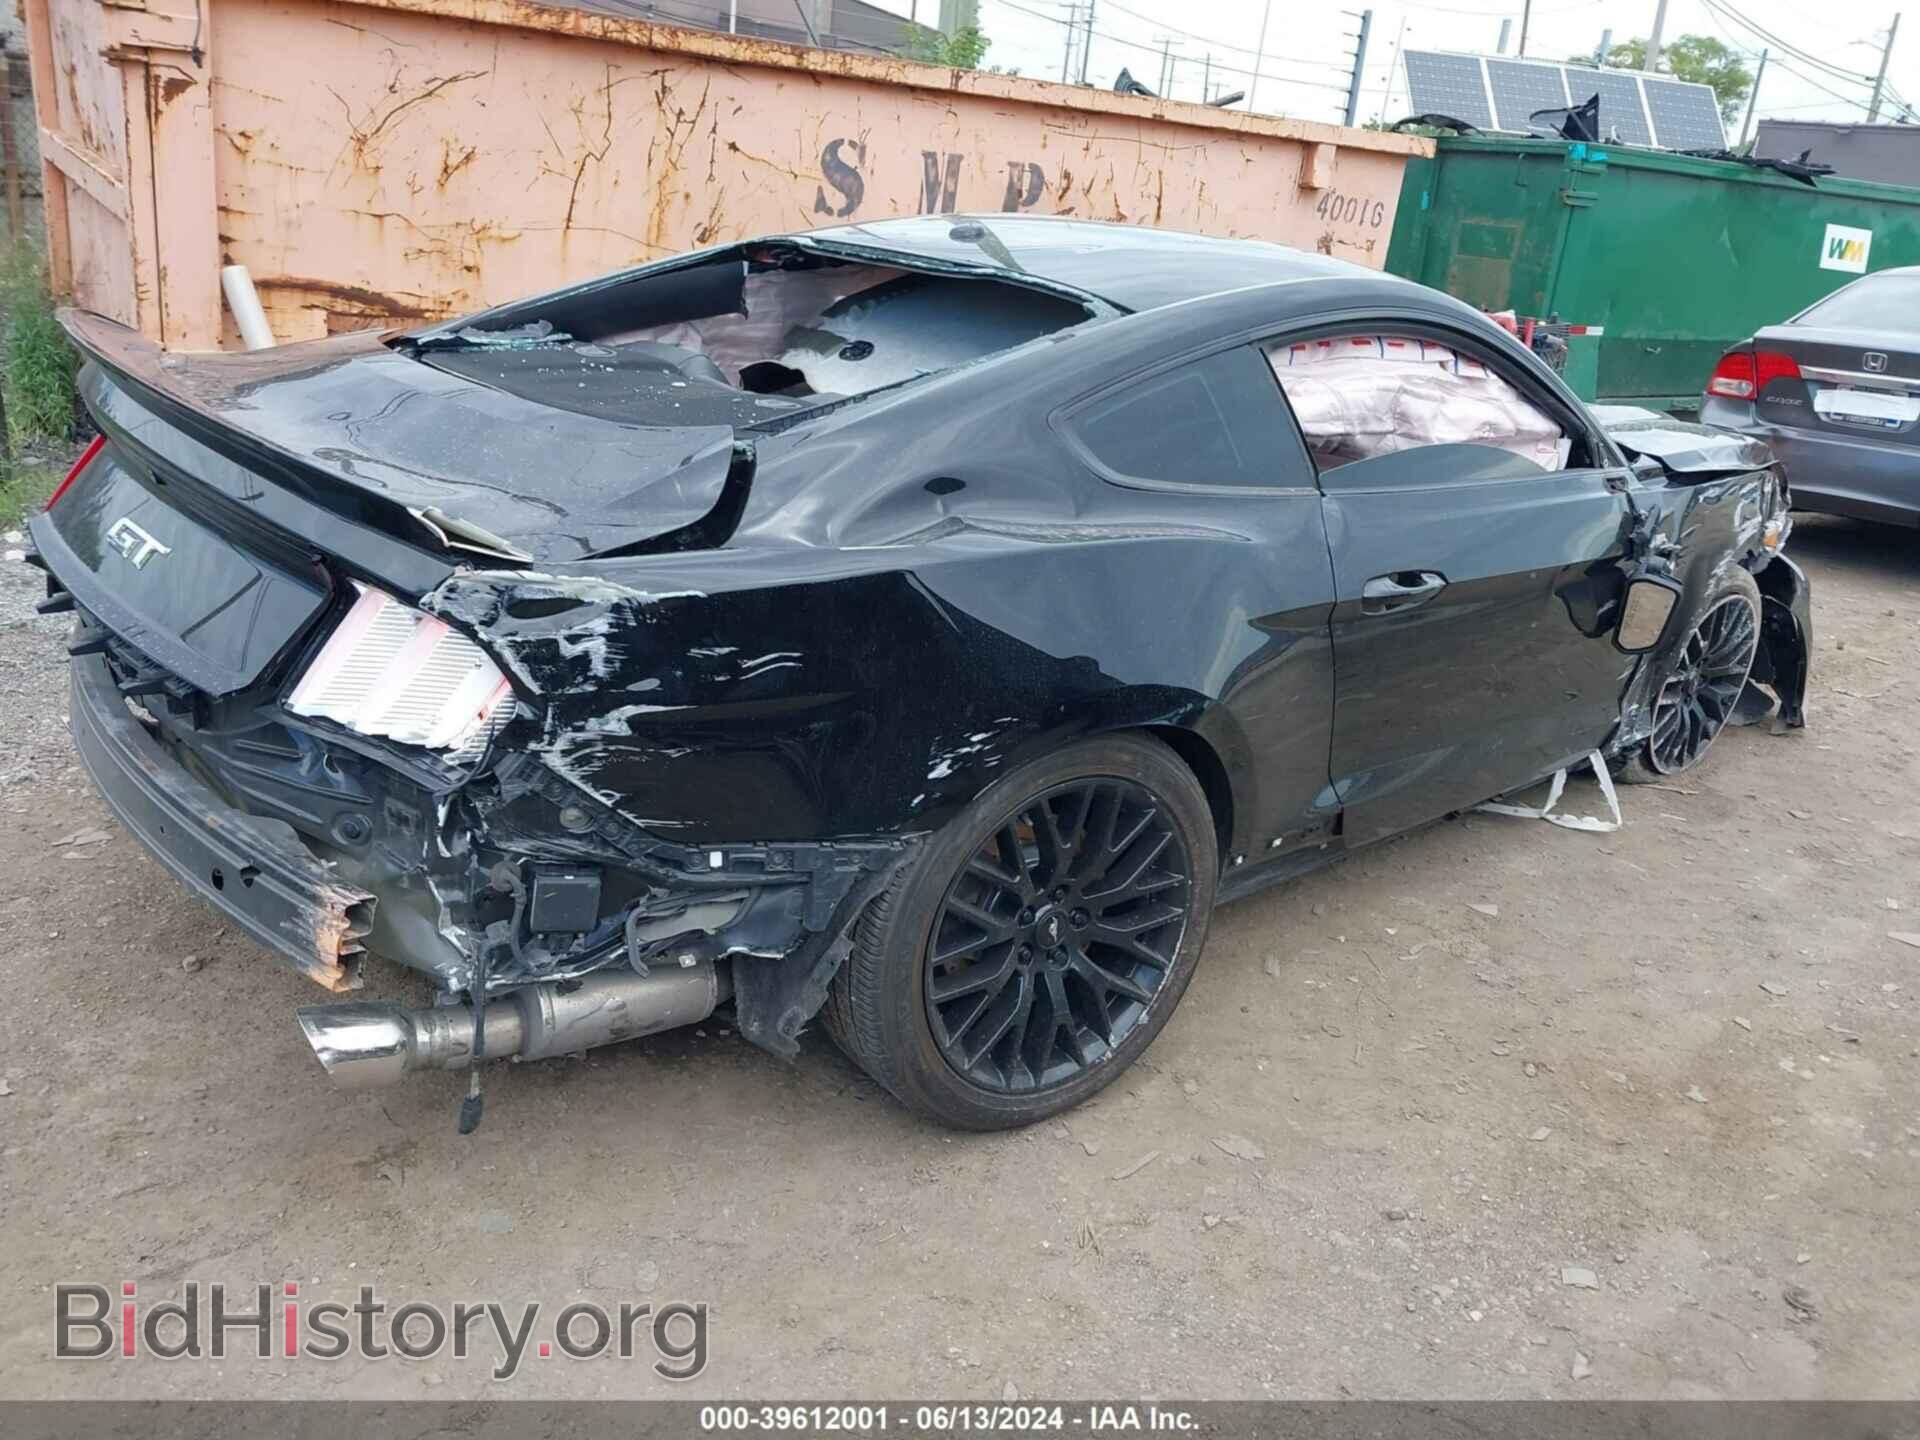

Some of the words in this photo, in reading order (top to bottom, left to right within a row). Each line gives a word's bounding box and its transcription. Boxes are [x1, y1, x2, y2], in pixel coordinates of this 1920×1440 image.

[1316, 190, 1385, 229] 40016
[1828, 237, 1866, 263] WM
[106, 517, 173, 571] GT
